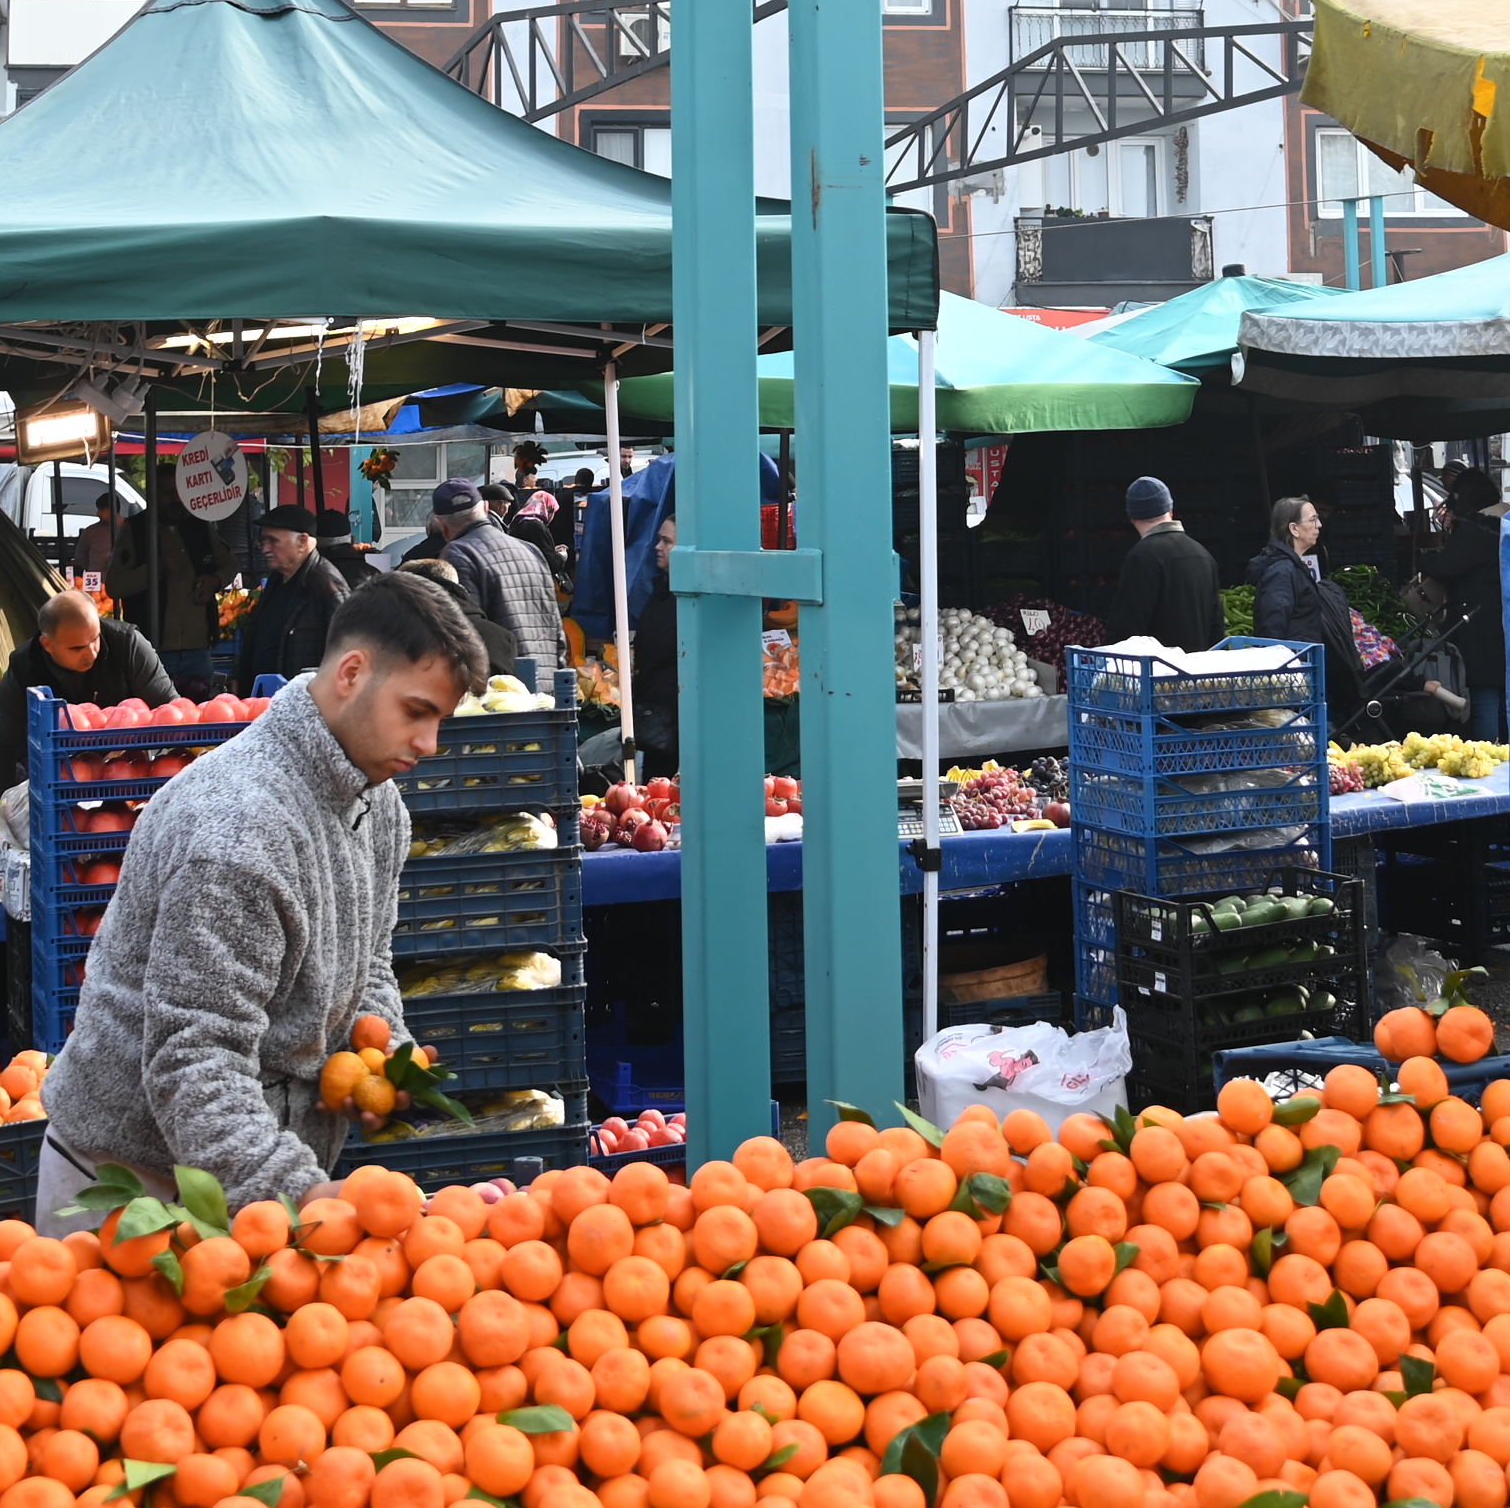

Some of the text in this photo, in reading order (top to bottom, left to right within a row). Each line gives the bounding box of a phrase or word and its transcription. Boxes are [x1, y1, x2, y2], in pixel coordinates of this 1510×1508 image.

[181, 445, 209, 467] KREDİ
[185, 470, 213, 489] KARTI
[189, 484, 242, 510] GEÇERLİDİR
[85, 578, 98, 586] 35
